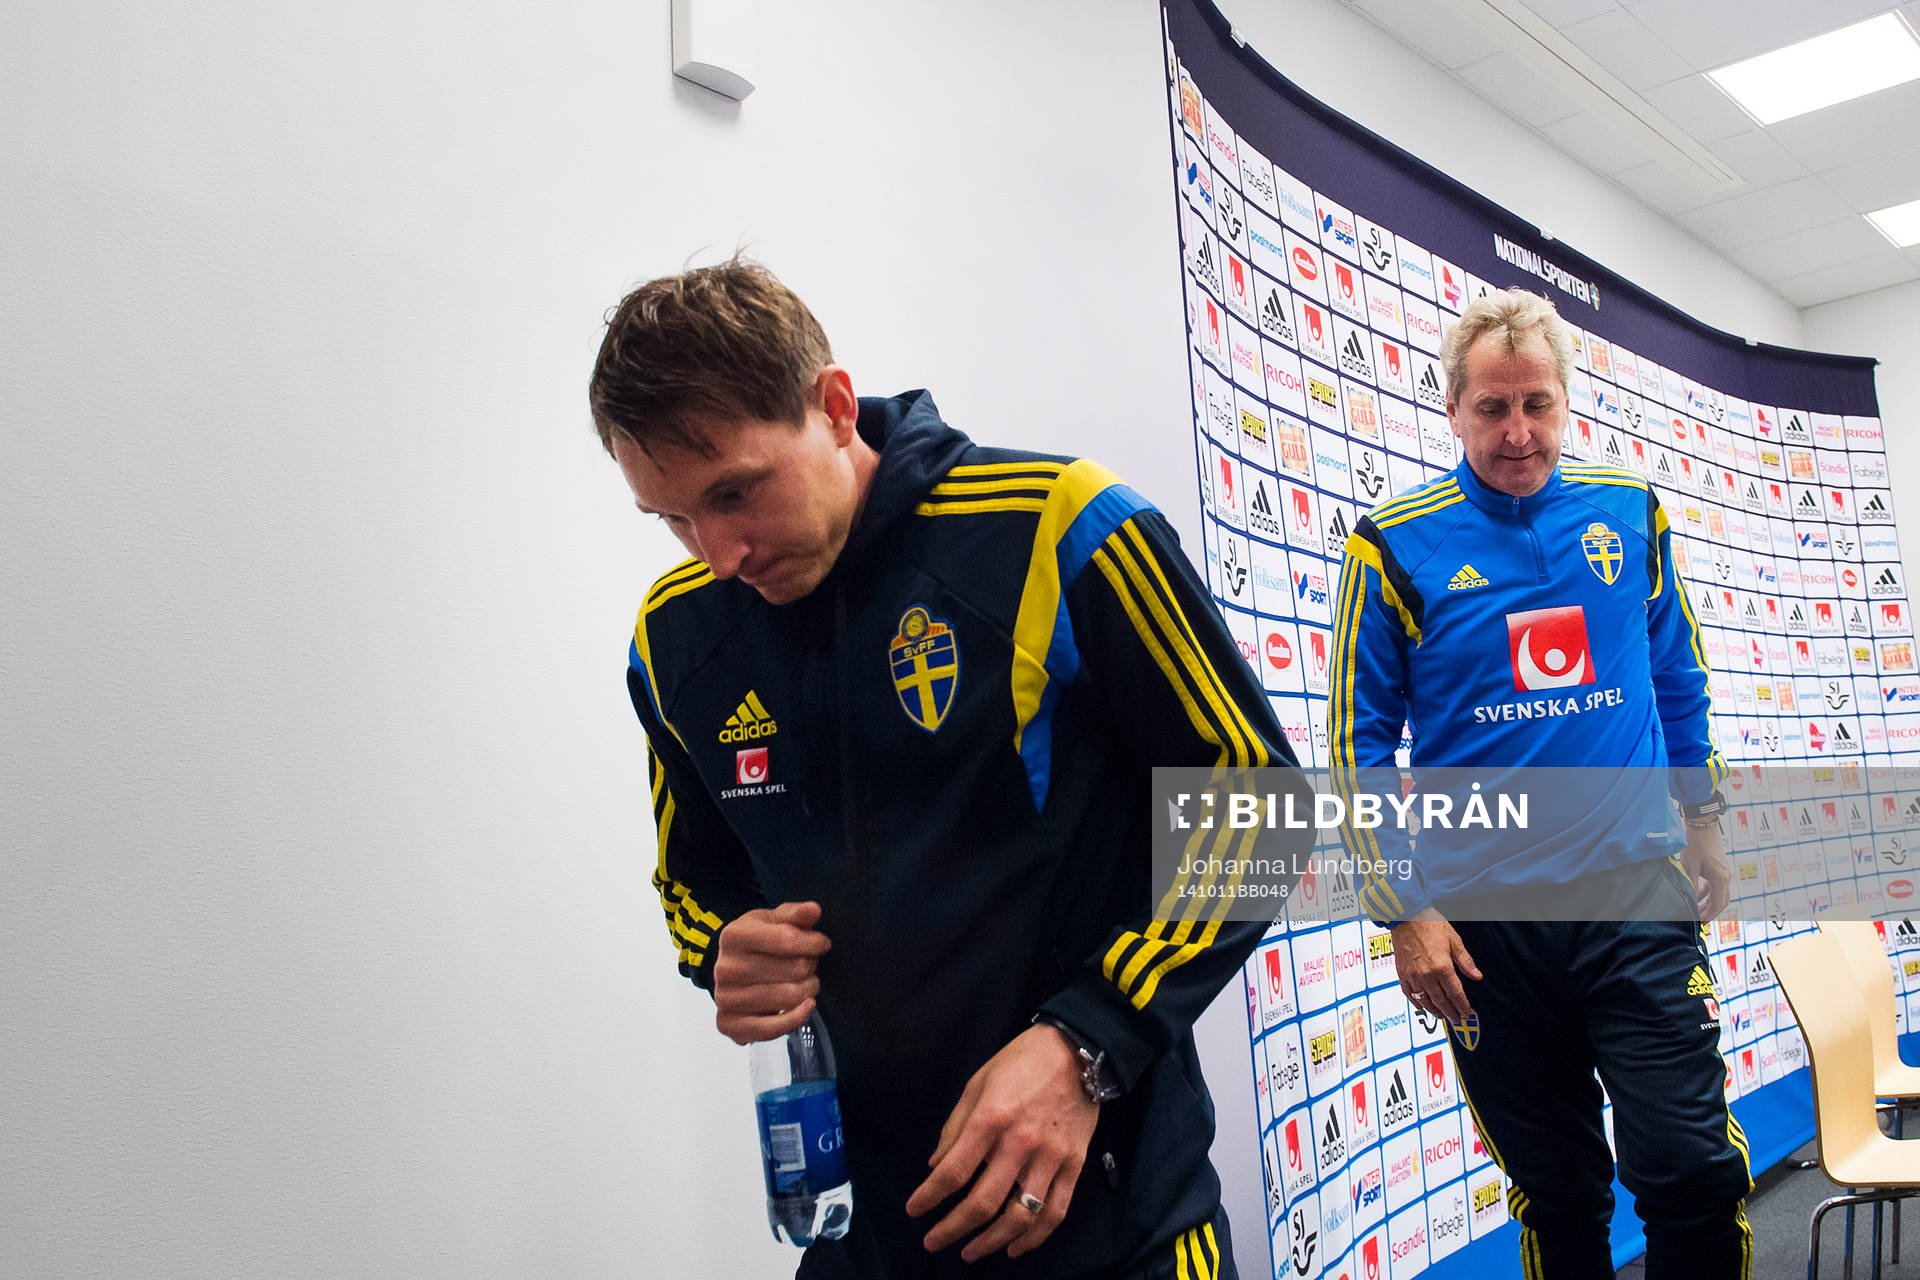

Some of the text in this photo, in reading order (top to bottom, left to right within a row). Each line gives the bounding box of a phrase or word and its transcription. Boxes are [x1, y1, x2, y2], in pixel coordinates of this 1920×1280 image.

[1224, 187, 1233, 214] SJ
[1371, 228, 1382, 249] SJ
[1196, 258, 1220, 294] adidas
[1494, 233, 1592, 305] NATIONALSPORTEN
[1262, 314, 1294, 342] adidas
[1406, 311, 1440, 337] RICOH
[1266, 363, 1302, 392] RICOH
[1341, 354, 1372, 379] adidas
[1309, 376, 1337, 409] SPORT
[1417, 387, 1447, 408] adidas
[1240, 408, 1267, 442] SPORT
[1384, 413, 1418, 440] Scandic
[1846, 429, 1883, 440] RICOH
[1281, 441, 1307, 461] GULD
[1315, 451, 1348, 475] postnord
[1363, 451, 1375, 474] SJ
[1249, 511, 1281, 536] adidas
[1228, 538, 1237, 566] SJ
[1447, 576, 1489, 591] adidas
[1803, 574, 1836, 584] RICOH
[903, 639, 936, 659] SvFF
[1828, 681, 1841, 695] SJ
[1473, 687, 1624, 724] SVENSKA SPEL
[718, 718, 778, 744] adidas
[721, 783, 787, 800] SVENSKA SPEL
[1334, 948, 1362, 974] RICOH
[1298, 970, 1326, 988] AVIATION
[1374, 1012, 1407, 1036] postnord
[1310, 1030, 1337, 1065] SPORT
[1383, 1101, 1414, 1128] adidas
[1320, 1140, 1345, 1170] adidas
[1424, 1135, 1462, 1166] RICOH
[1361, 1167, 1381, 1187] INTER
[1363, 1183, 1383, 1209] SPORT
[1473, 1179, 1502, 1213] SPORT
[1293, 1208, 1305, 1241] SJ
[1432, 1213, 1465, 1242] Fabege
[1391, 1226, 1427, 1263] Scandic
